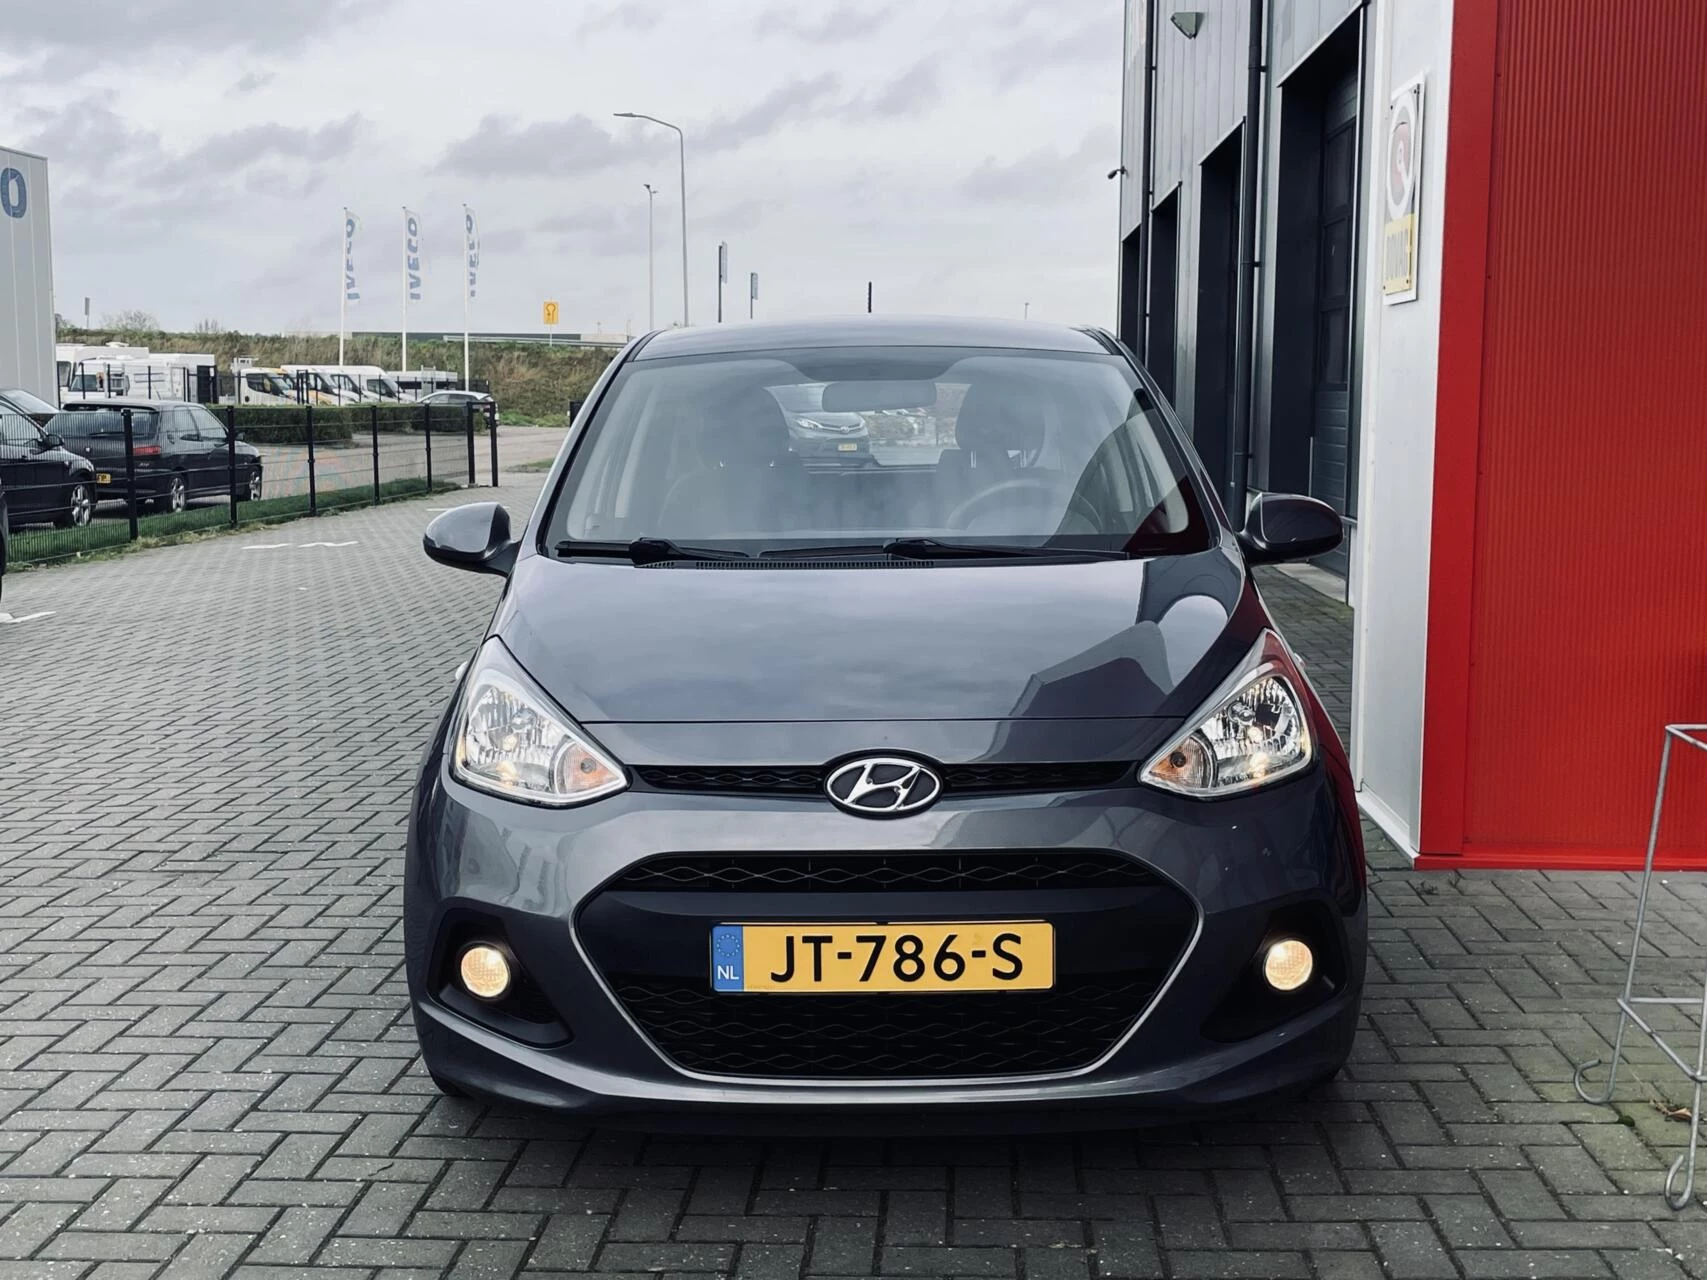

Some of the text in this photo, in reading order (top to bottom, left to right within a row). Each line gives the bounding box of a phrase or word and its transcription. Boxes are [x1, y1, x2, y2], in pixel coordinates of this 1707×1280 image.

[407, 217, 422, 300] IVECO
[716, 965, 740, 981] NL
[770, 932, 1023, 983] JT-786-S
